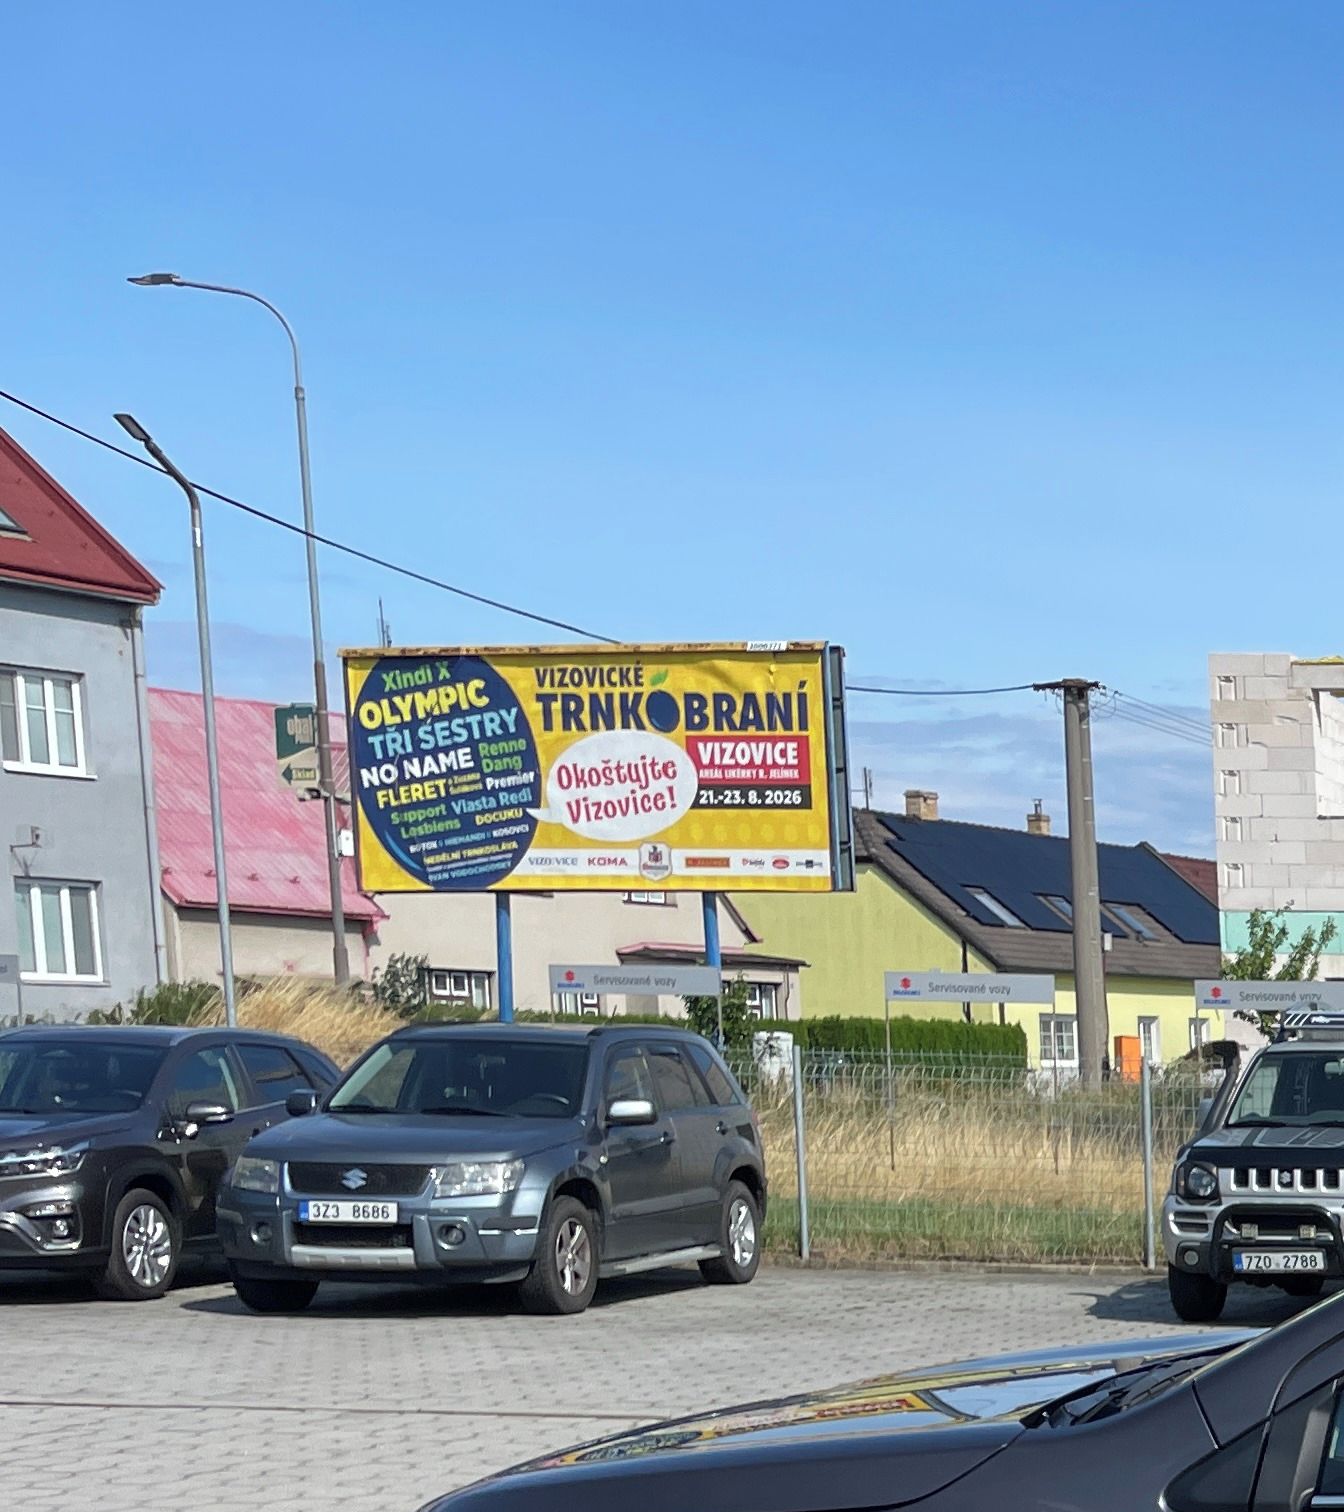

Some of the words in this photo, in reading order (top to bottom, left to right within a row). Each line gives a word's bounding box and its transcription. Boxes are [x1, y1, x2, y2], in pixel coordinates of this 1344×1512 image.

[435, 661, 451, 681] X
[535, 660, 645, 688] VIZOVICKÉ
[359, 679, 490, 730] OLYMPIC
[368, 726, 413, 760] TŘI
[418, 707, 518, 750] SESTRY
[481, 756, 522, 774] Dang
[698, 742, 798, 765] VIZOVICE
[360, 763, 399, 789] NO
[403, 747, 475, 780] NAME
[557, 755, 678, 790] Okoštujte
[376, 779, 447, 809] FLERET
[451, 797, 497, 815] Vlasta
[499, 787, 533, 807] Redl
[566, 786, 678, 824] Vizovice!
[699, 790, 744, 804] 21.-23.
[748, 790, 762, 804] 8.
[765, 790, 802, 804] 2026
[391, 803, 447, 825] Support
[475, 808, 523, 826] DOCUKU
[587, 857, 628, 866] KOMA
[352, 1204, 389, 1219] 8686
[1246, 1255, 1272, 1269] 7Z0
[1282, 1254, 1317, 1269] 2788
